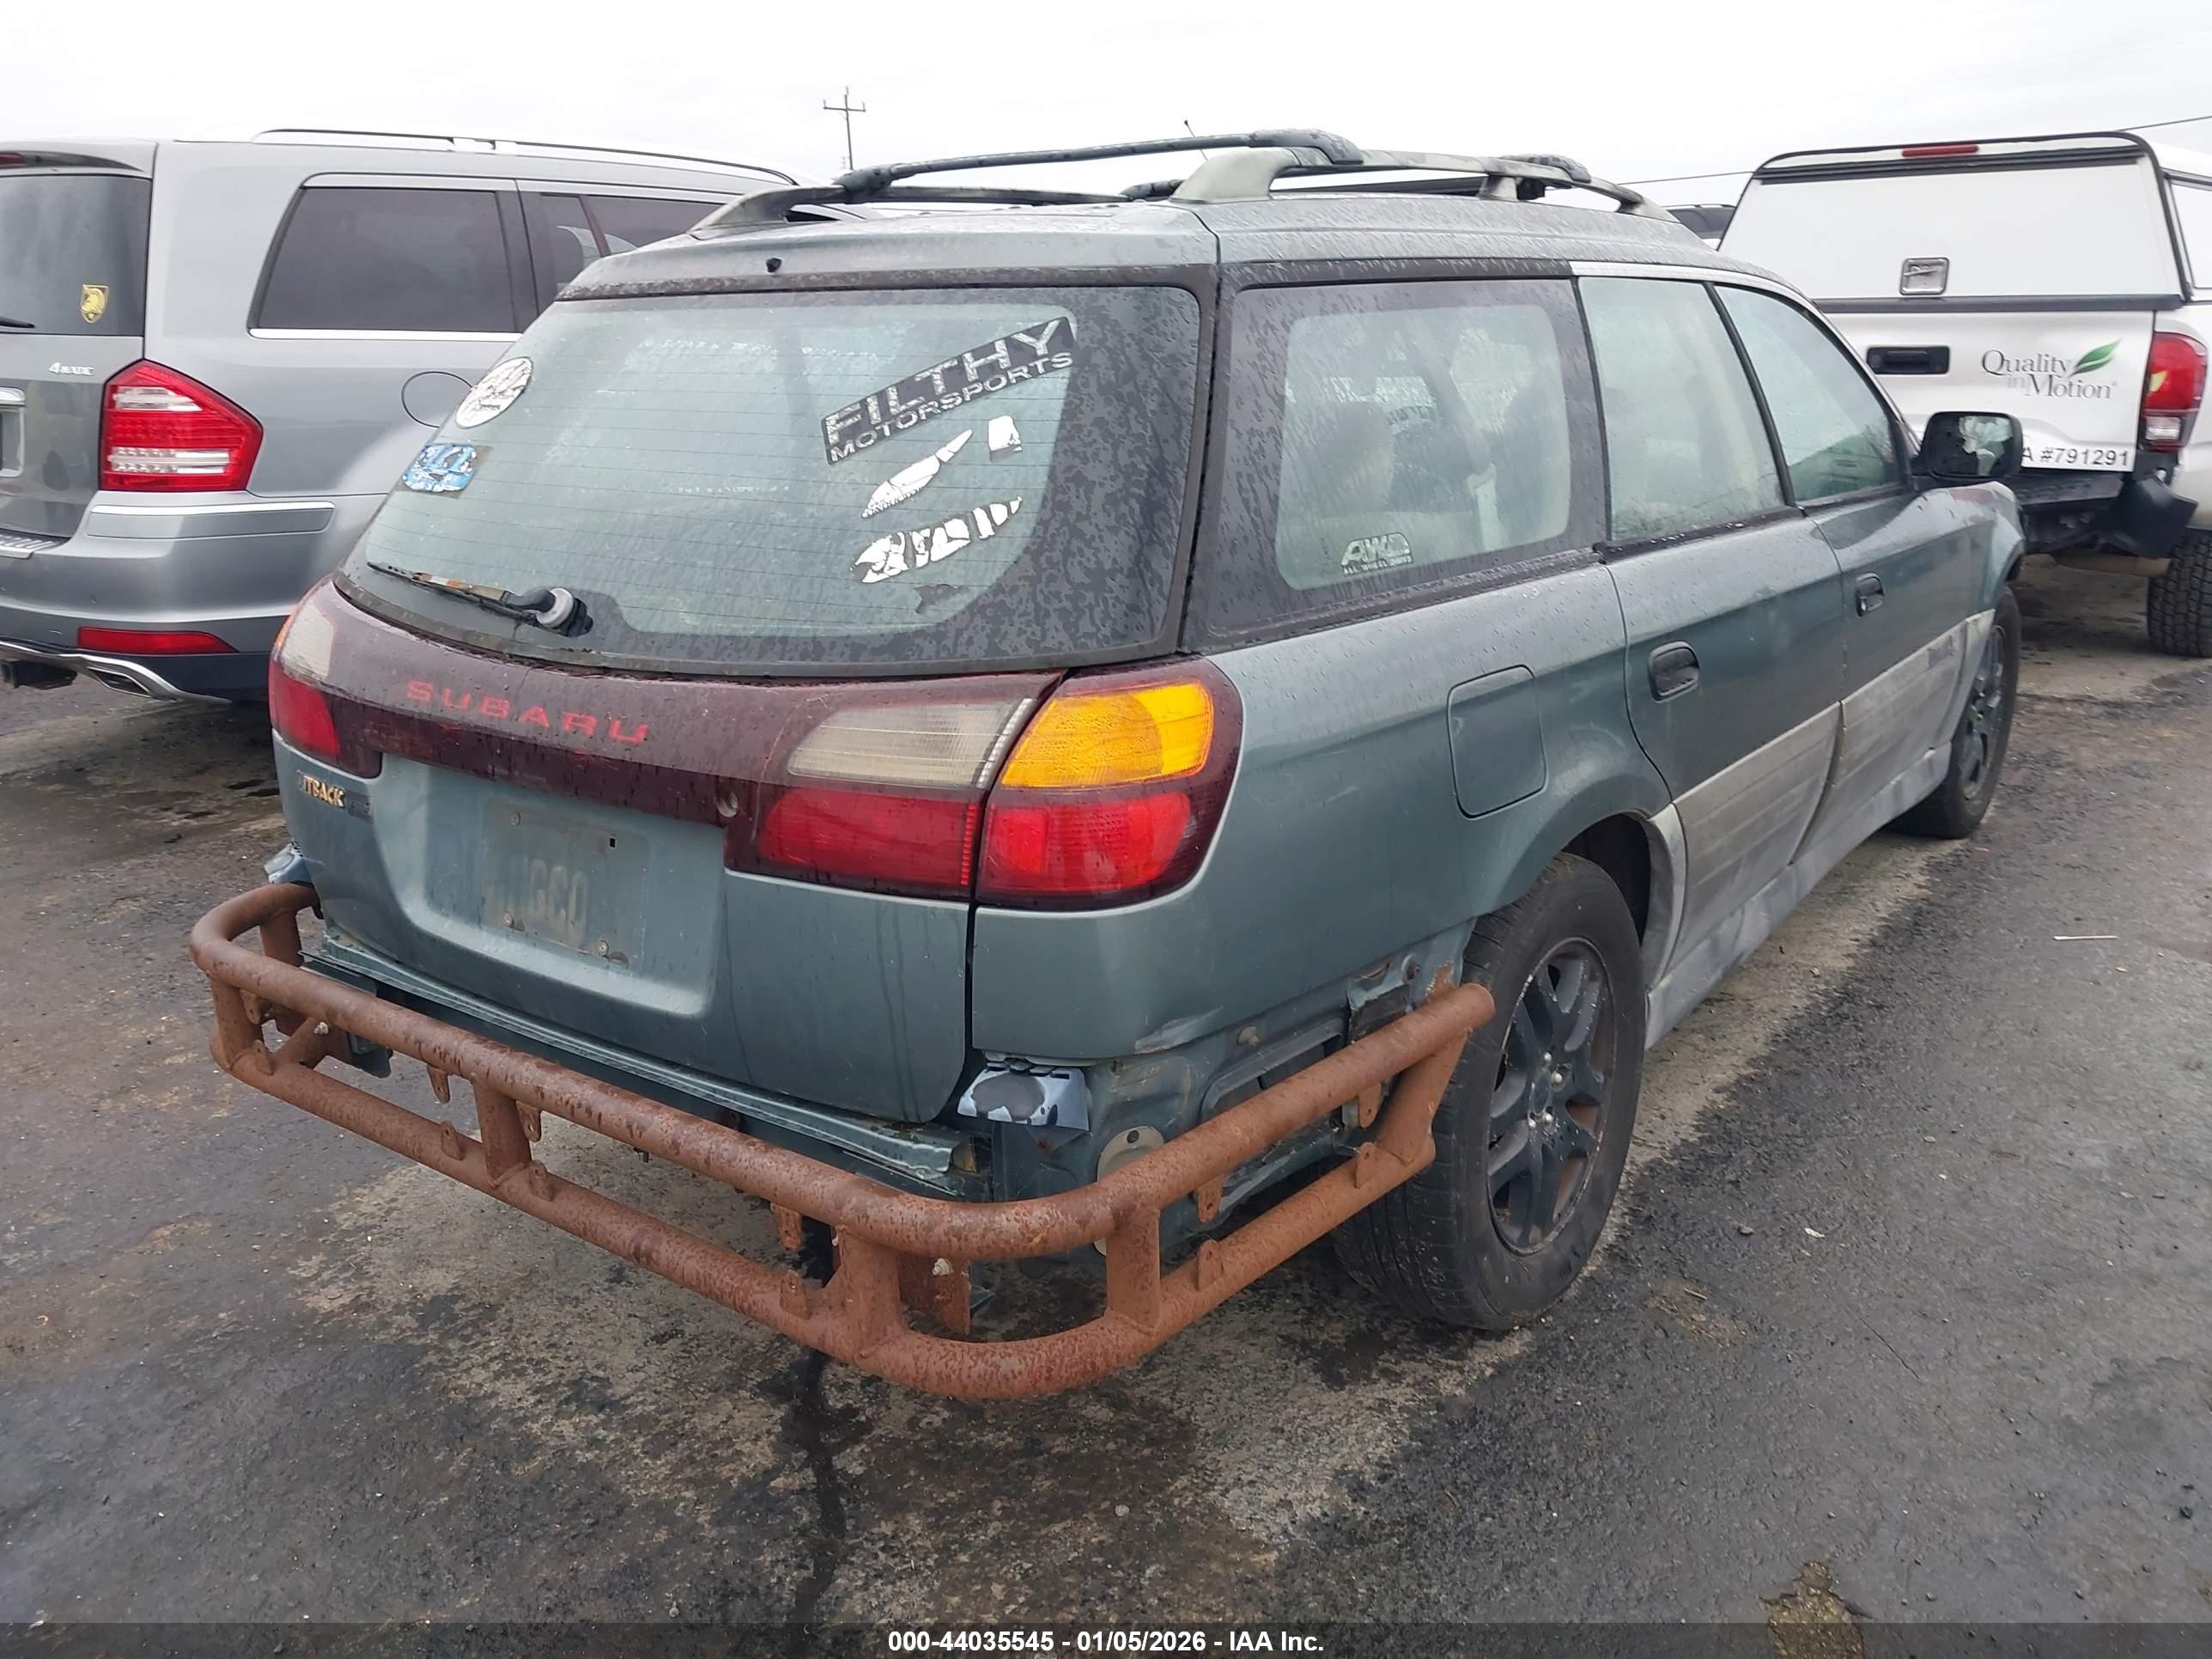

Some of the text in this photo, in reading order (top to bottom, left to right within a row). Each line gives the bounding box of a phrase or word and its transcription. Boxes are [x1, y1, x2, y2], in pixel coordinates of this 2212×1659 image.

[825, 319, 1060, 445] FILTHY
[1981, 349, 2072, 379] Quality
[2023, 373, 2112, 399] Motion
[830, 351, 1073, 462] MOTORSPORTS
[2039, 447, 2130, 466] #791291
[406, 678, 648, 744] SUBARU
